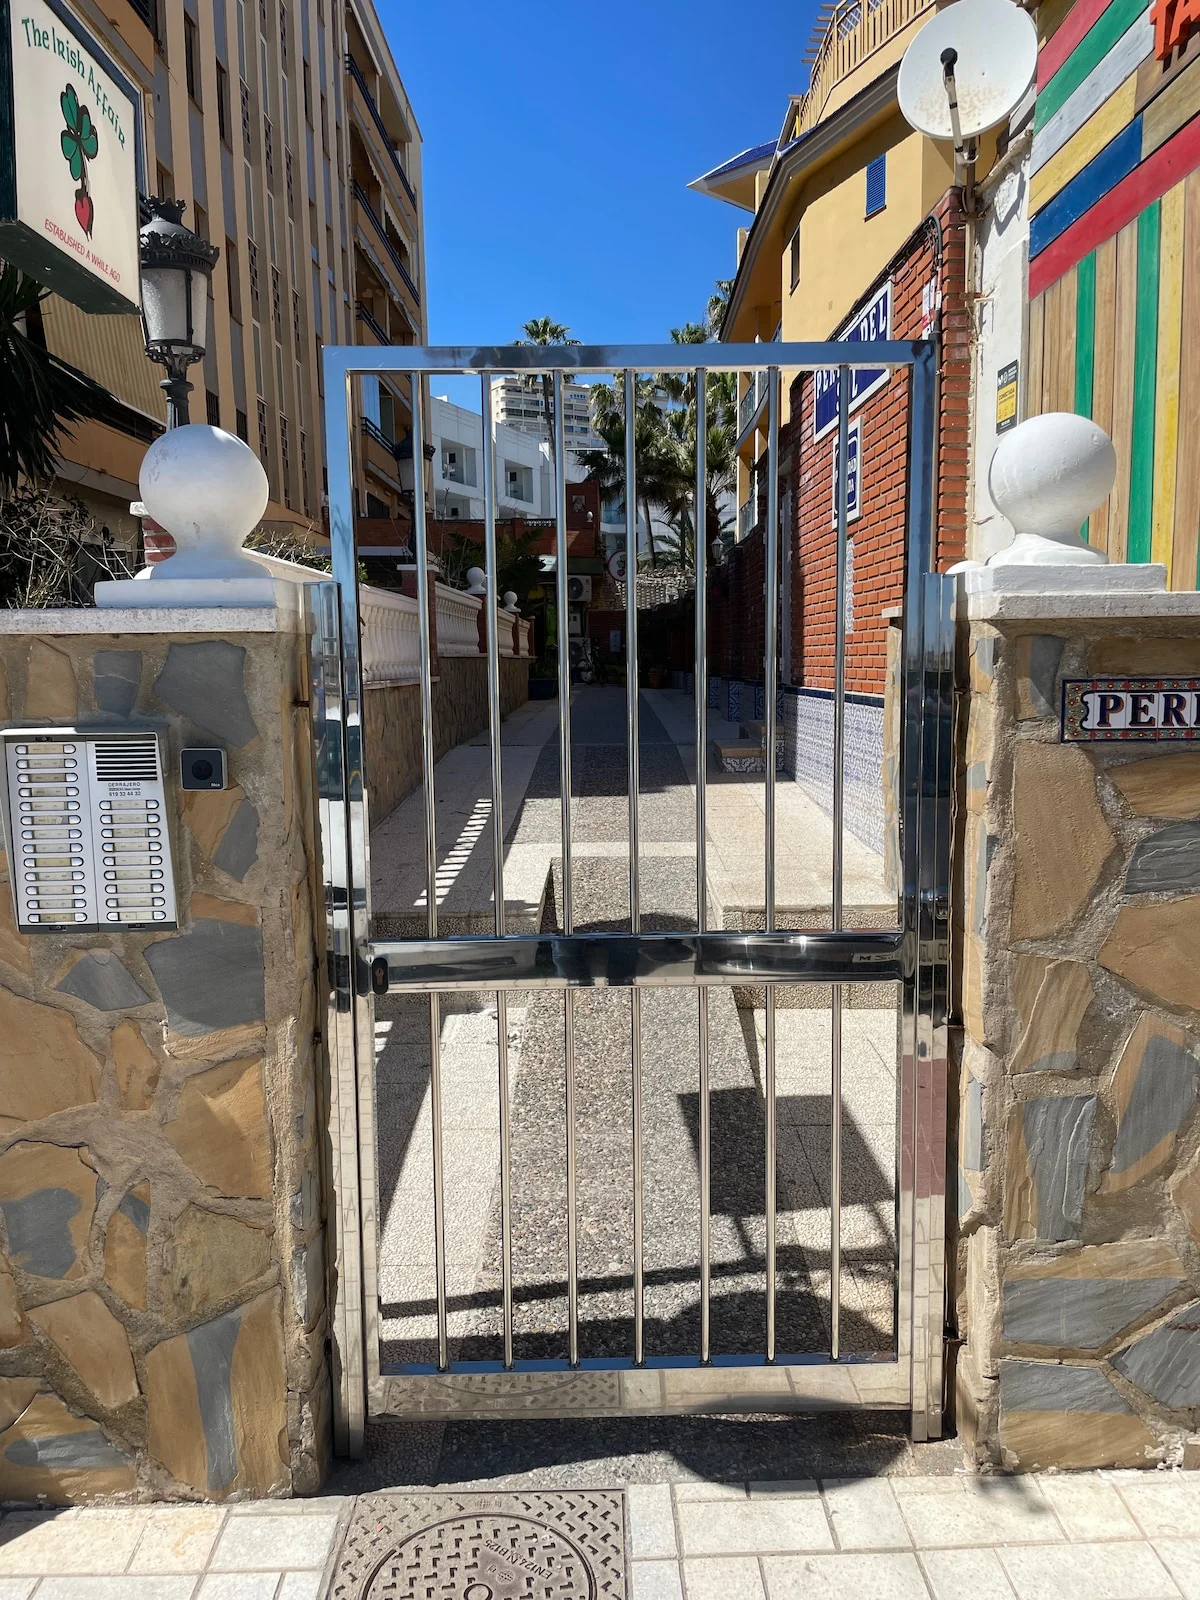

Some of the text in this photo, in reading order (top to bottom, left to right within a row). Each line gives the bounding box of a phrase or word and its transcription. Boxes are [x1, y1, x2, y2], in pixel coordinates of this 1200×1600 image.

[22, 18, 50, 50] The
[45, 219, 121, 283] ESTABLISHED A WHILE AGO
[1097, 693, 1200, 727] PER
[484, 1539, 509, 1556] B125
